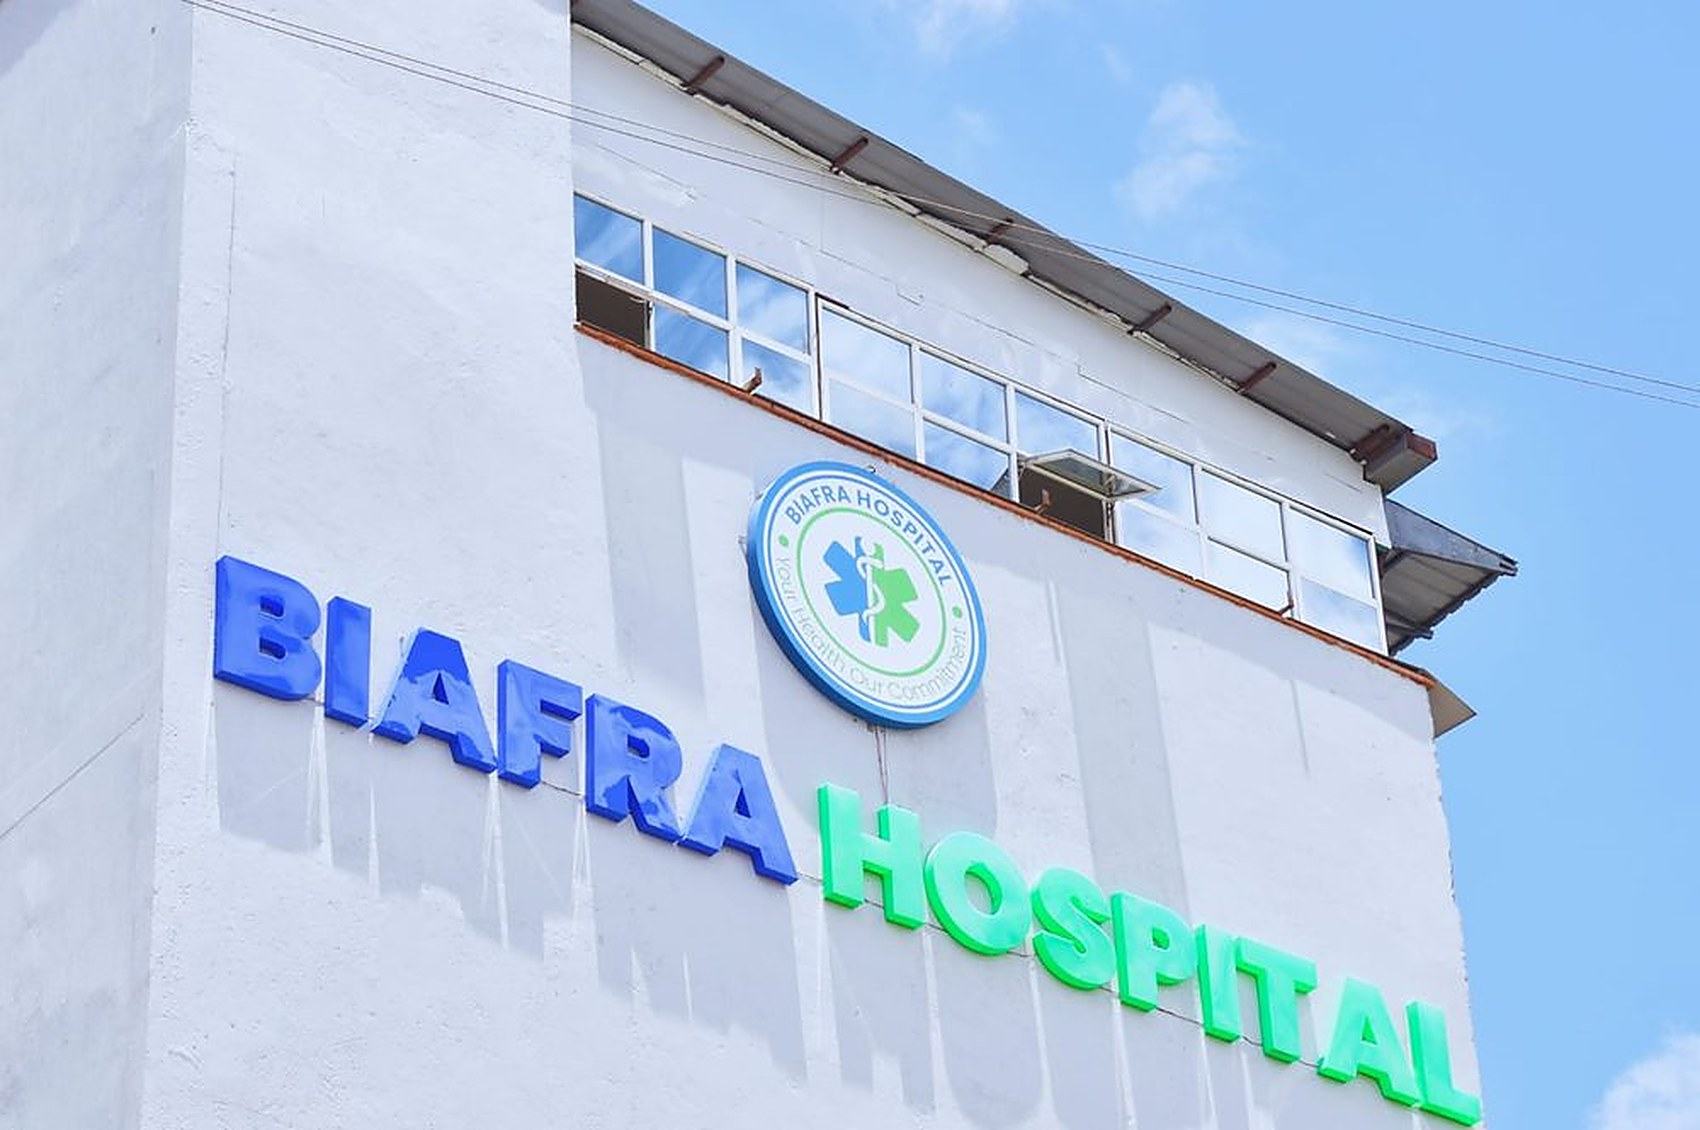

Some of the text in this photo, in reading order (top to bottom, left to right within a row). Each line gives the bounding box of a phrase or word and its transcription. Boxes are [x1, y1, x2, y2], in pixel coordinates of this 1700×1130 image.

[785, 485, 952, 586] BIAFRA HOSPITAL
[775, 558, 967, 701] Your Health Our Commitment
[213, 556, 1482, 1127] BIAFRA HOSPITAL
